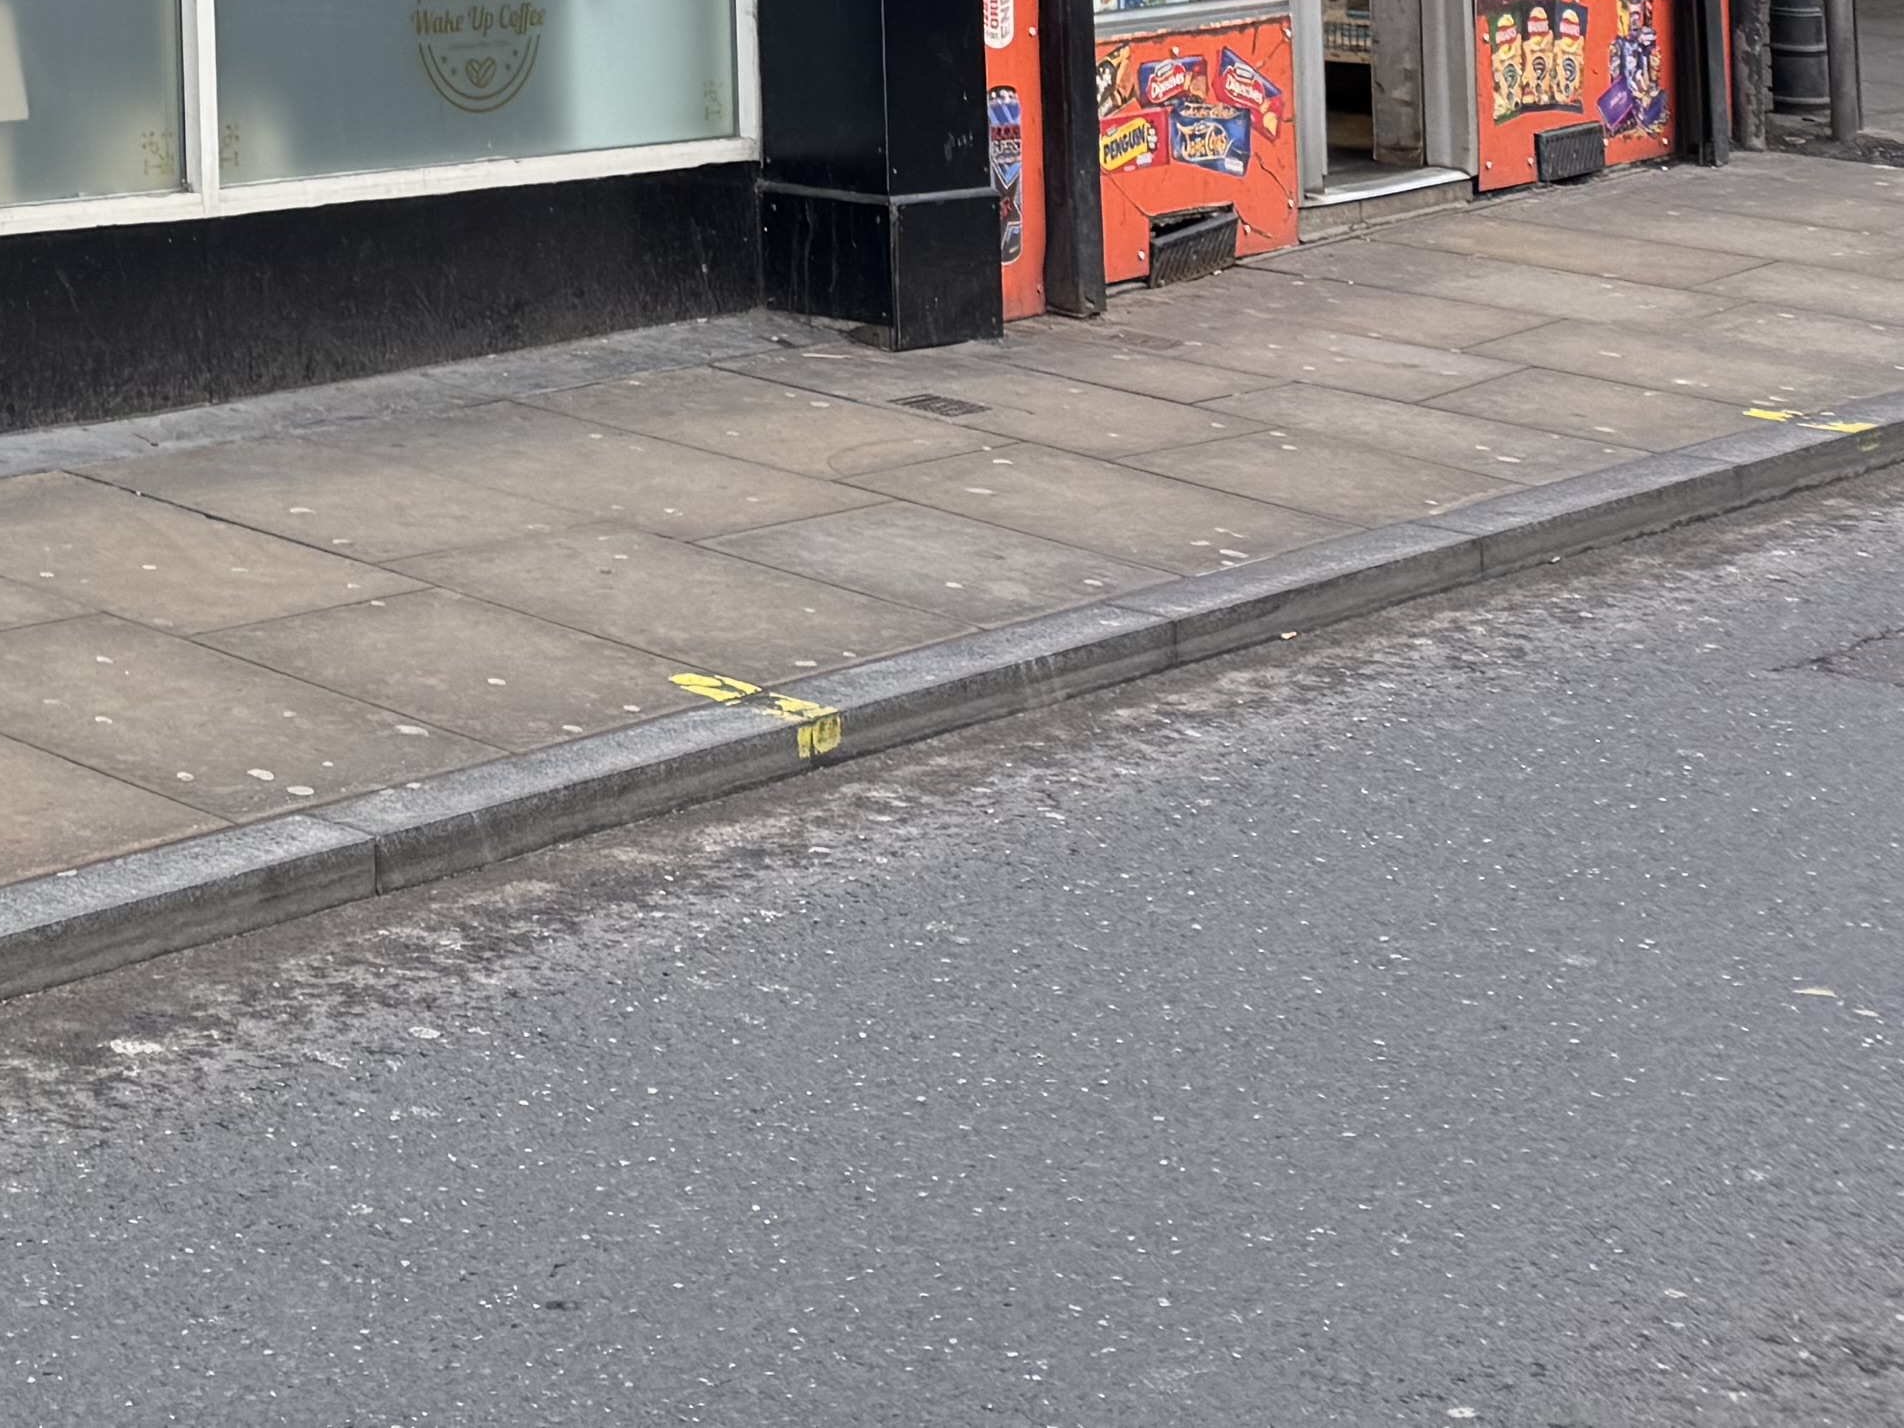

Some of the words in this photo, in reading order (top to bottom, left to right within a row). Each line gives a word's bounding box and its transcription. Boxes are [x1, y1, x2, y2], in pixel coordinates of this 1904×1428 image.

[411, 9, 465, 36] Wake
[468, 5, 494, 38] Up
[1103, 123, 1147, 166] PENGUIN
